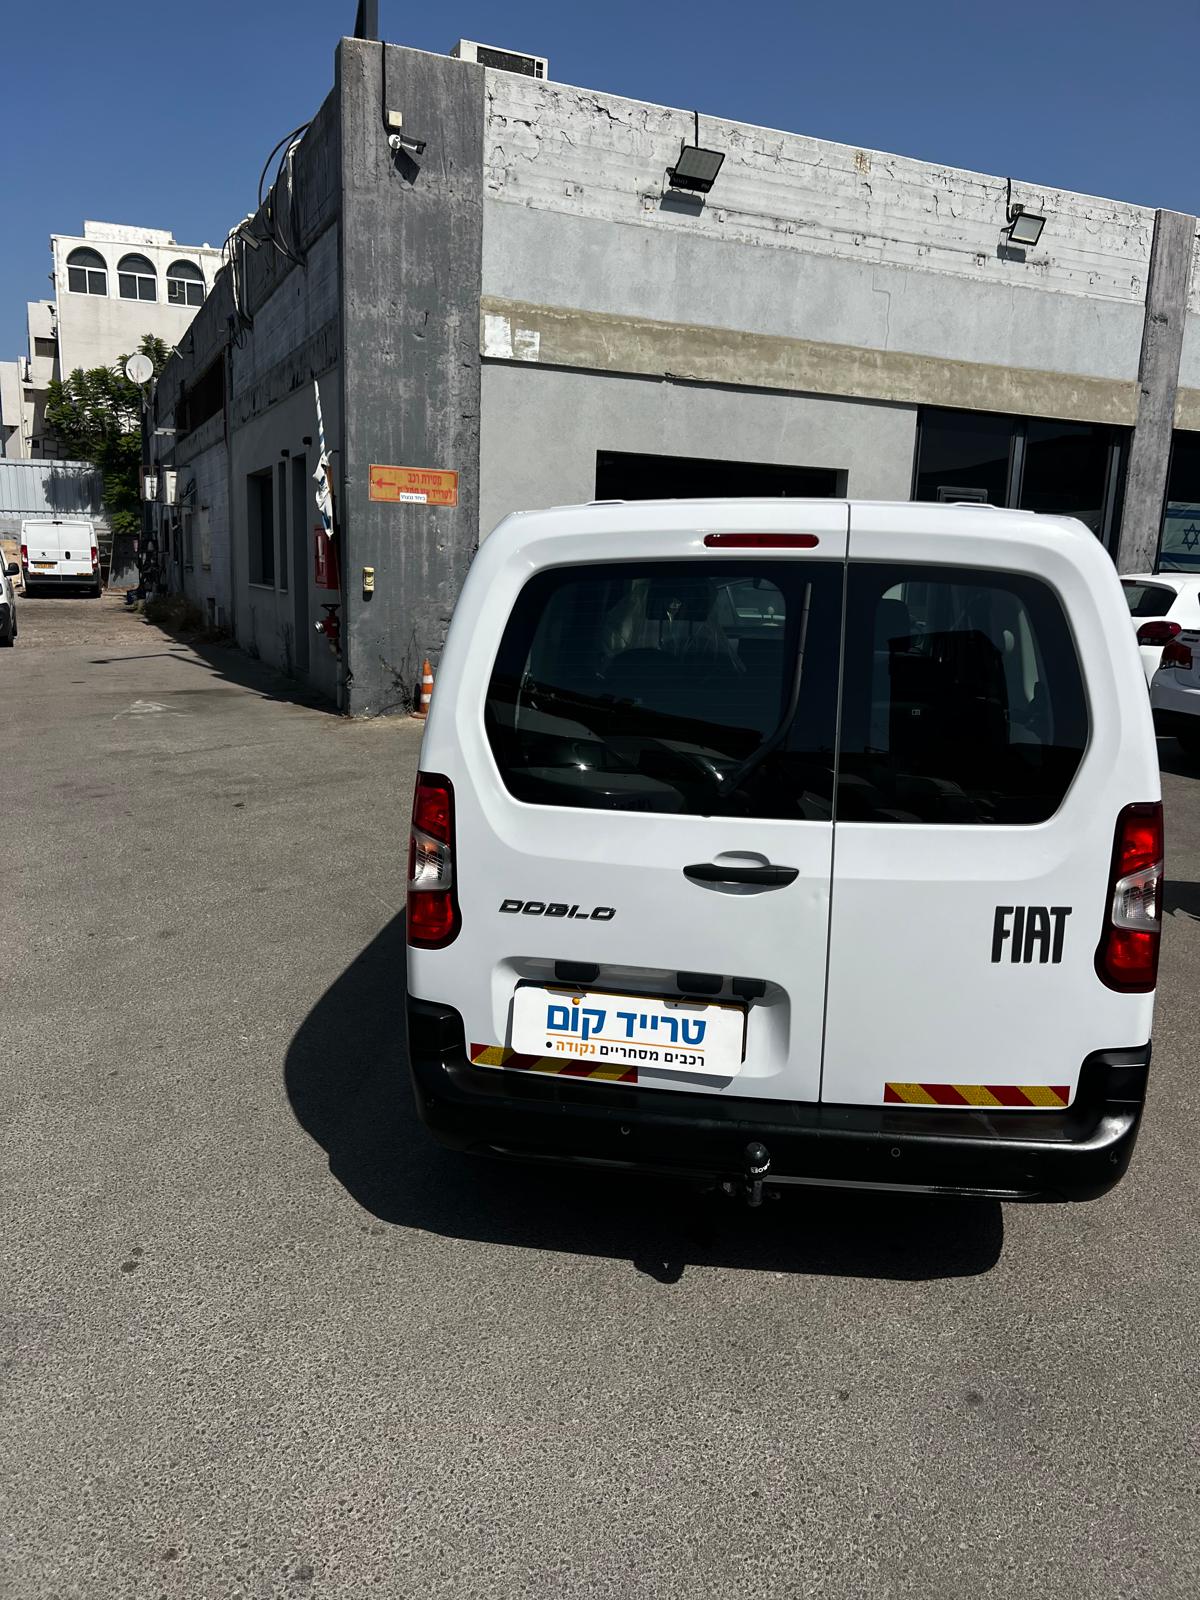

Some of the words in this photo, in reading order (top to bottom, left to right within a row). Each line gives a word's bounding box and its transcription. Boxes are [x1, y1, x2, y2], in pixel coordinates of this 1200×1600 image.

[408, 473, 420, 484] רכב
[421, 474, 442, 486] מסירת
[498, 899, 617, 921] DOBLO
[991, 906, 1072, 964] FIAT
[546, 1003, 607, 1041] קום
[616, 1011, 707, 1045] טרייד
[556, 1040, 596, 1056] נקודה
[600, 1045, 659, 1061] מסחריים
[664, 1052, 705, 1067] רכבים
